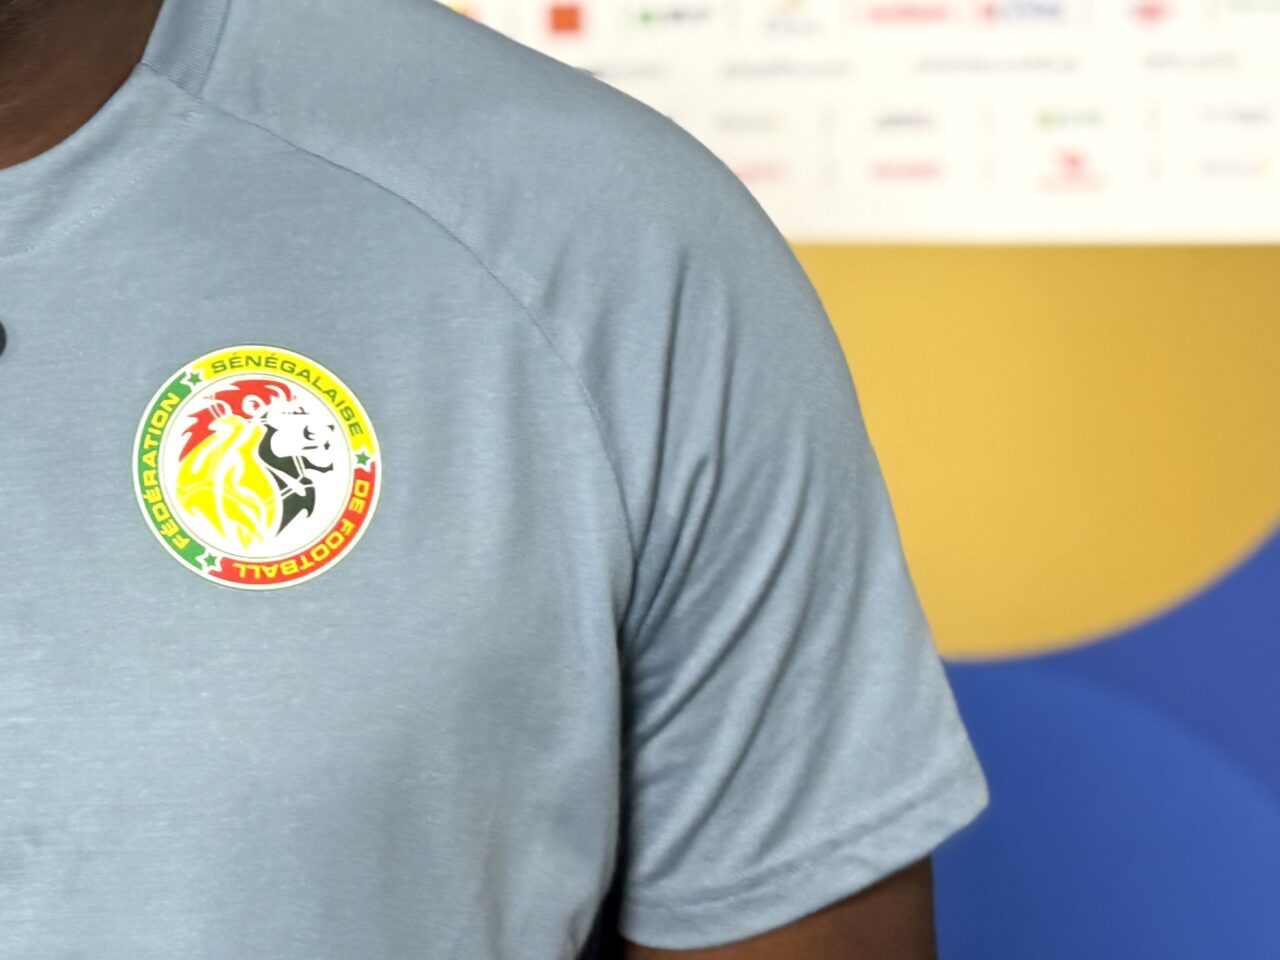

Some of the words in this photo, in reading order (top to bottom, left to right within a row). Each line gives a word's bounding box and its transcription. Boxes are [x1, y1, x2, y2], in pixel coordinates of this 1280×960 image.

[211, 352, 365, 438] SÉNÉGALAISE
[142, 392, 191, 551] FÉDÉRATION
[347, 479, 371, 514] DE
[231, 516, 356, 580] FOOTBALL
